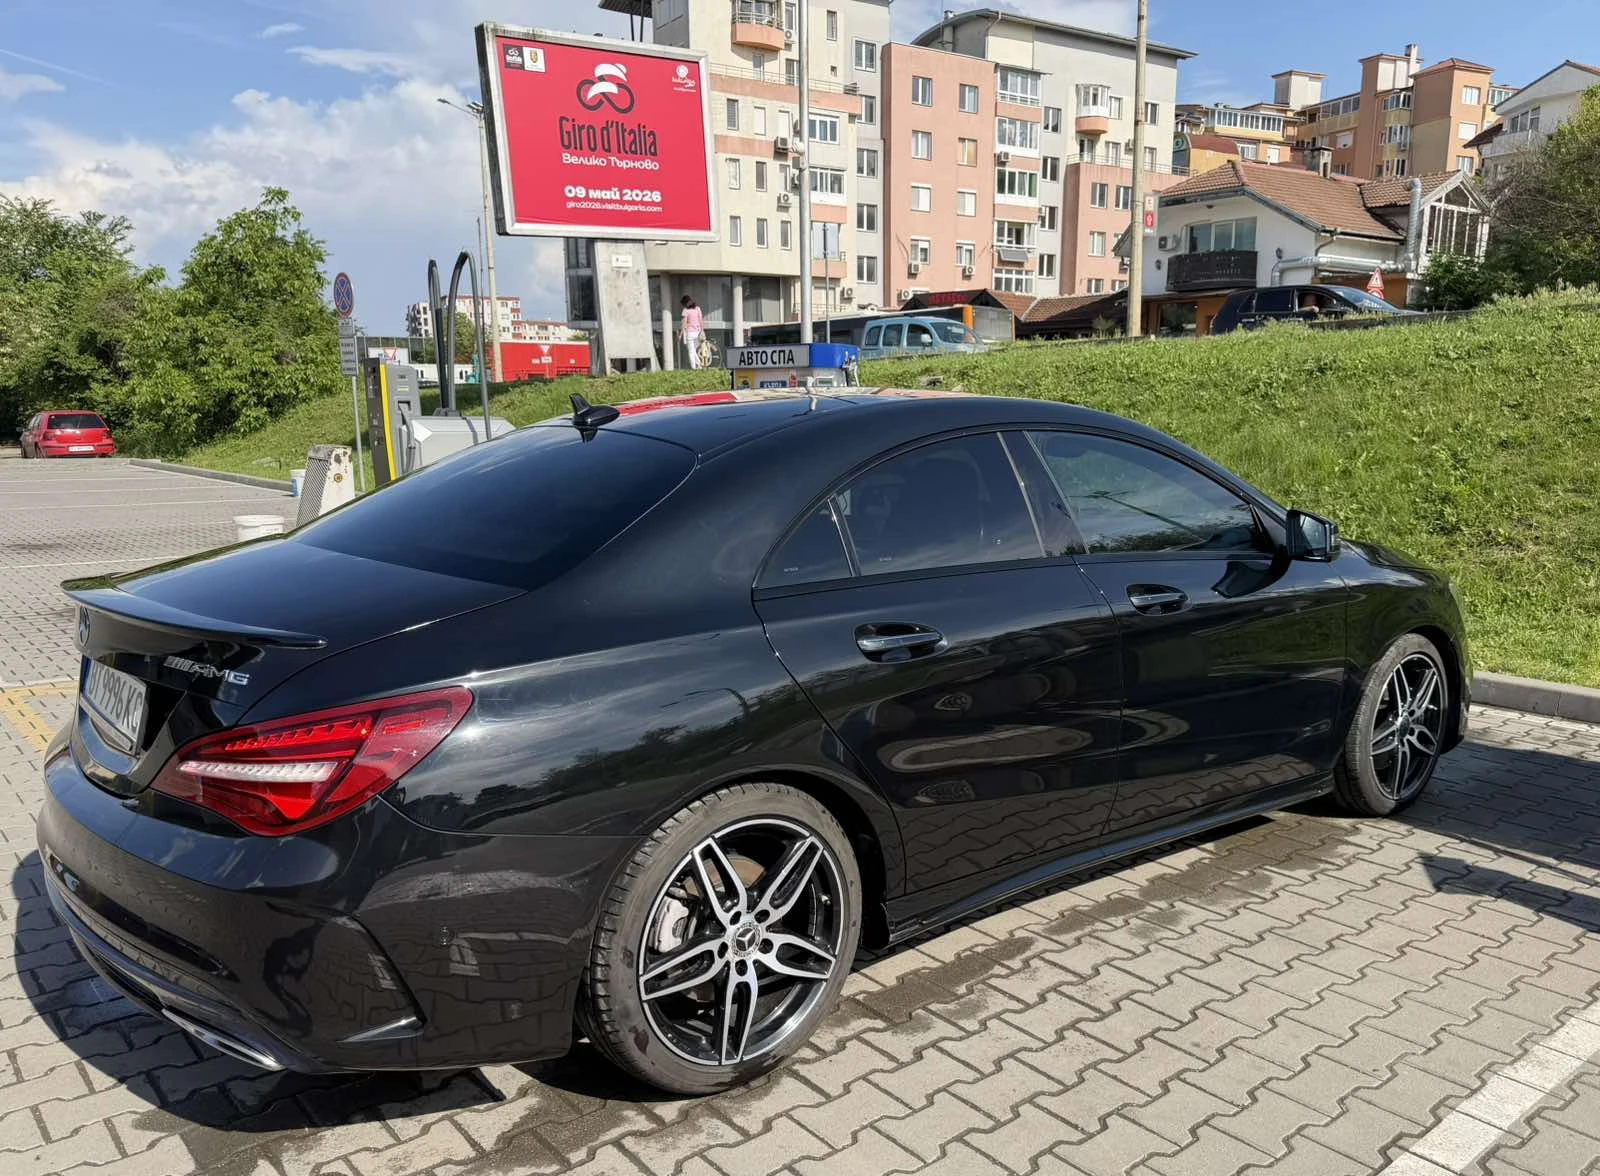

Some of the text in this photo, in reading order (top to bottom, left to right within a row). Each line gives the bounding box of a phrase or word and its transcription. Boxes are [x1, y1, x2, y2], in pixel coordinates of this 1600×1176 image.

[559, 116, 658, 157] Giro d'Italia
[562, 152, 660, 170] Велико Търново
[564, 185, 662, 203] 09 май 2026
[738, 349, 795, 366] АВТО СПА
[190, 661, 250, 686] AMG
